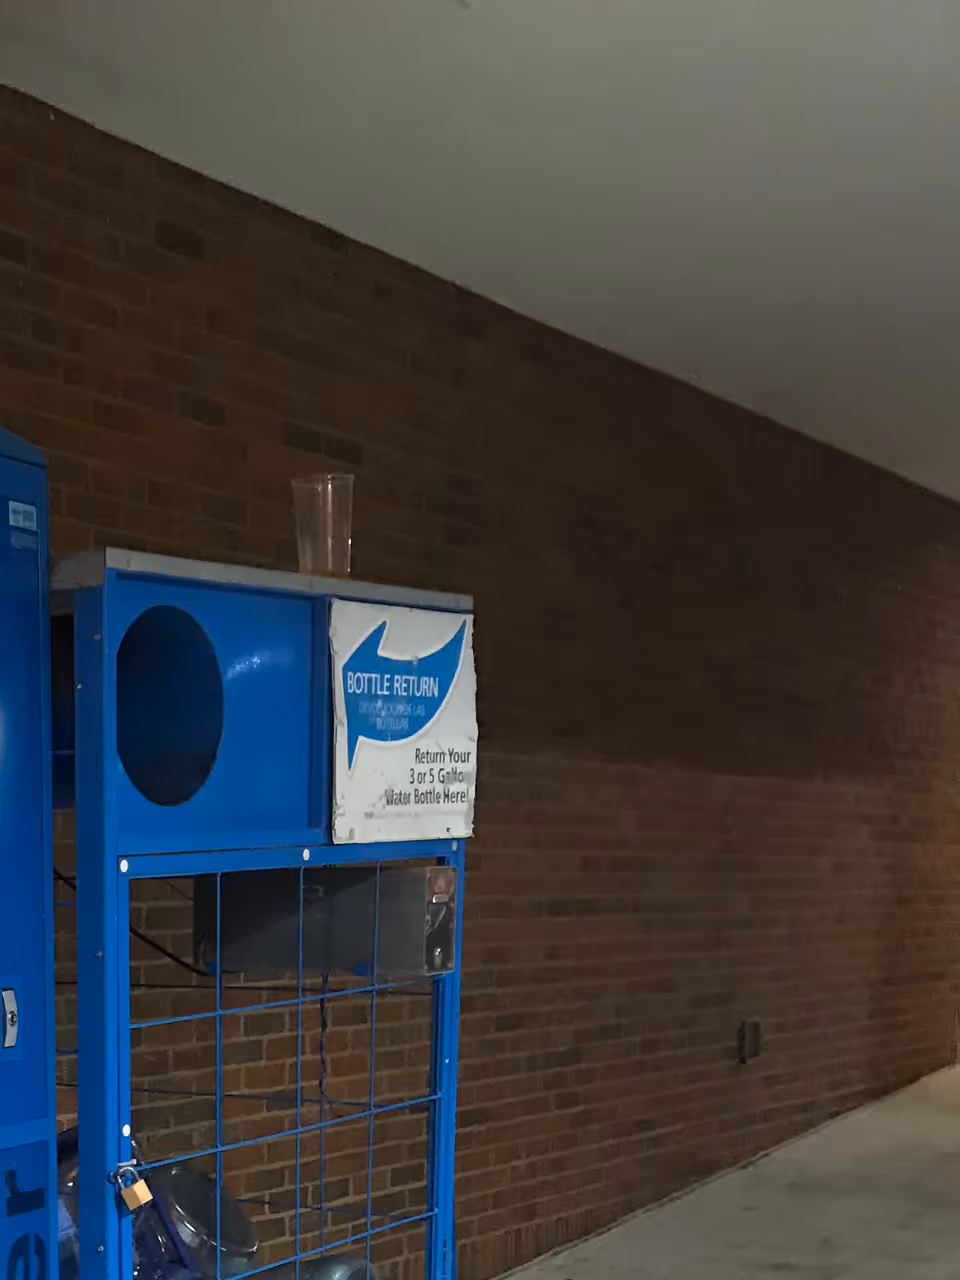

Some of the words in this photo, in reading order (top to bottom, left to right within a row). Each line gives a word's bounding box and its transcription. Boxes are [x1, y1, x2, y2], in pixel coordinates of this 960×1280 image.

[347, 672, 389, 695] BOTTLE
[393, 675, 439, 697] RETURN
[415, 748, 446, 764] Return
[448, 748, 471, 763] Your
[410, 768, 415, 784] 3
[418, 771, 427, 784] or
[429, 768, 435, 783] 5
[385, 789, 411, 805] Water
[414, 787, 441, 804] Bottle
[443, 787, 469, 803] Here!
